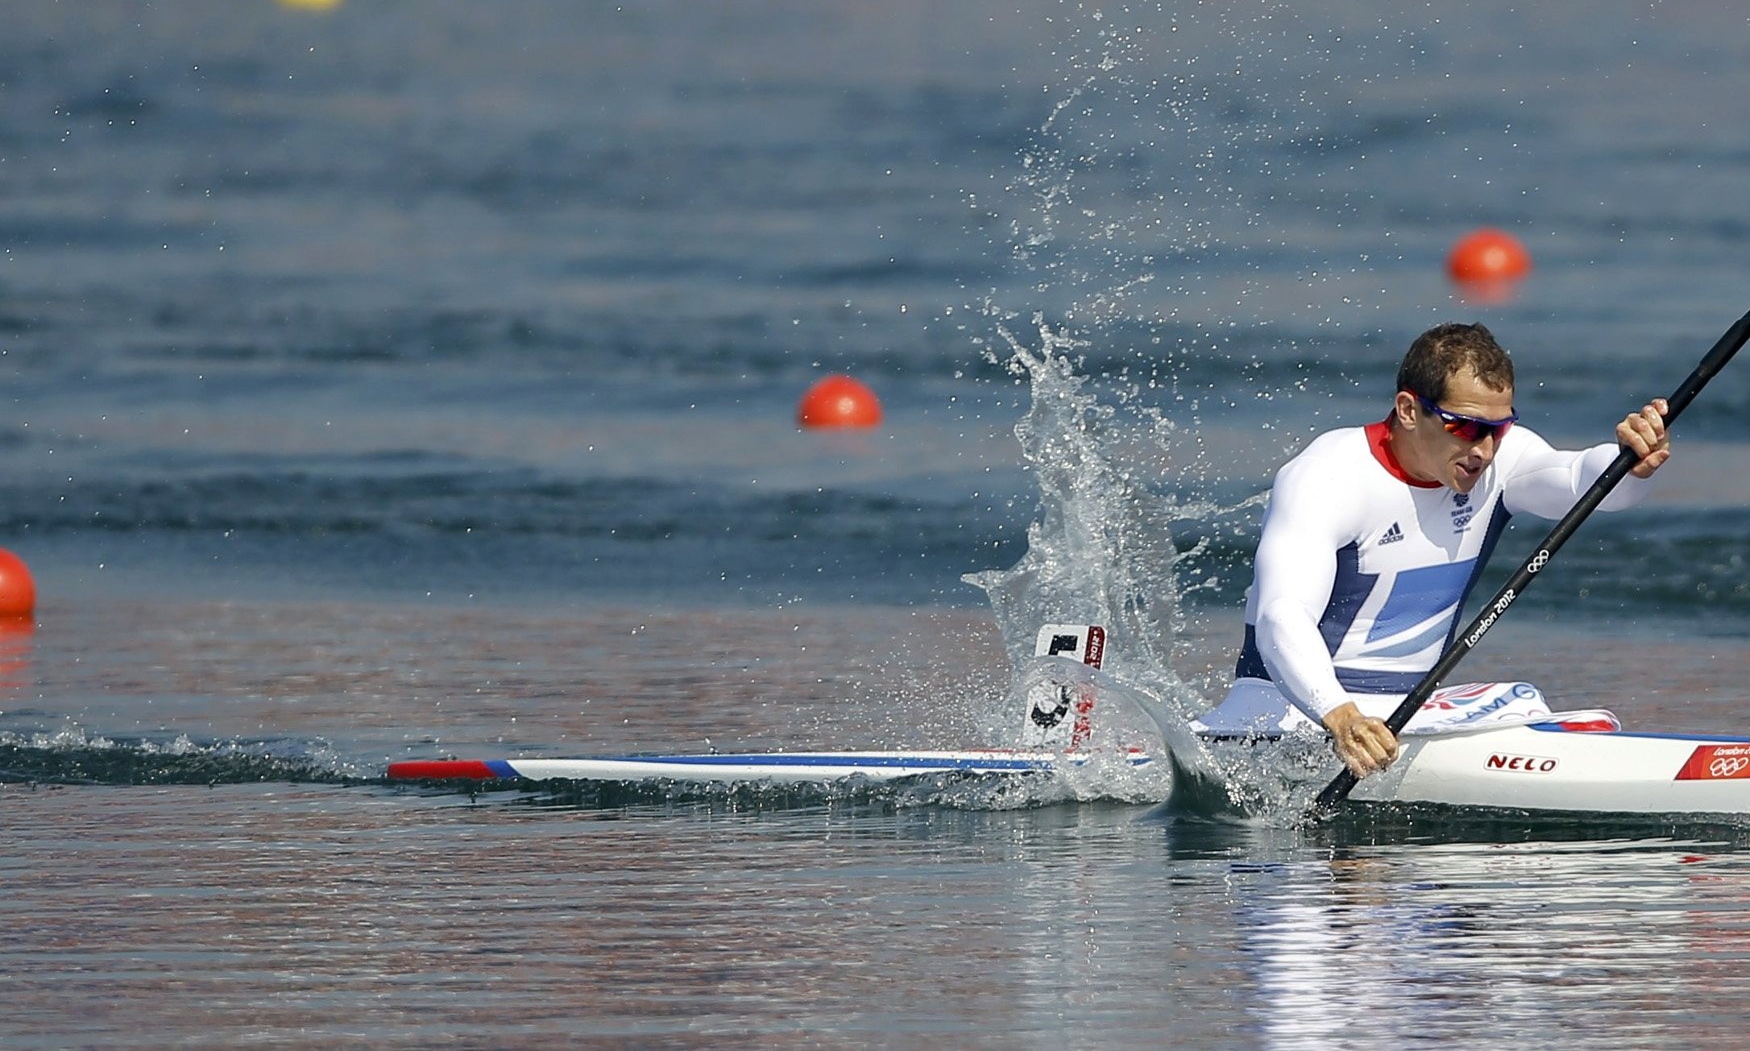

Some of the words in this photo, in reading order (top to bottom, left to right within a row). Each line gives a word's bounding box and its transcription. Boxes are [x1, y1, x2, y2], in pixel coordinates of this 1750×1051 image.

[1378, 534, 1404, 545] adidas
[1464, 612, 1497, 648] London
[1494, 589, 1516, 614] 2012
[1713, 746, 1744, 756] London
[1487, 755, 1556, 772] NELO
